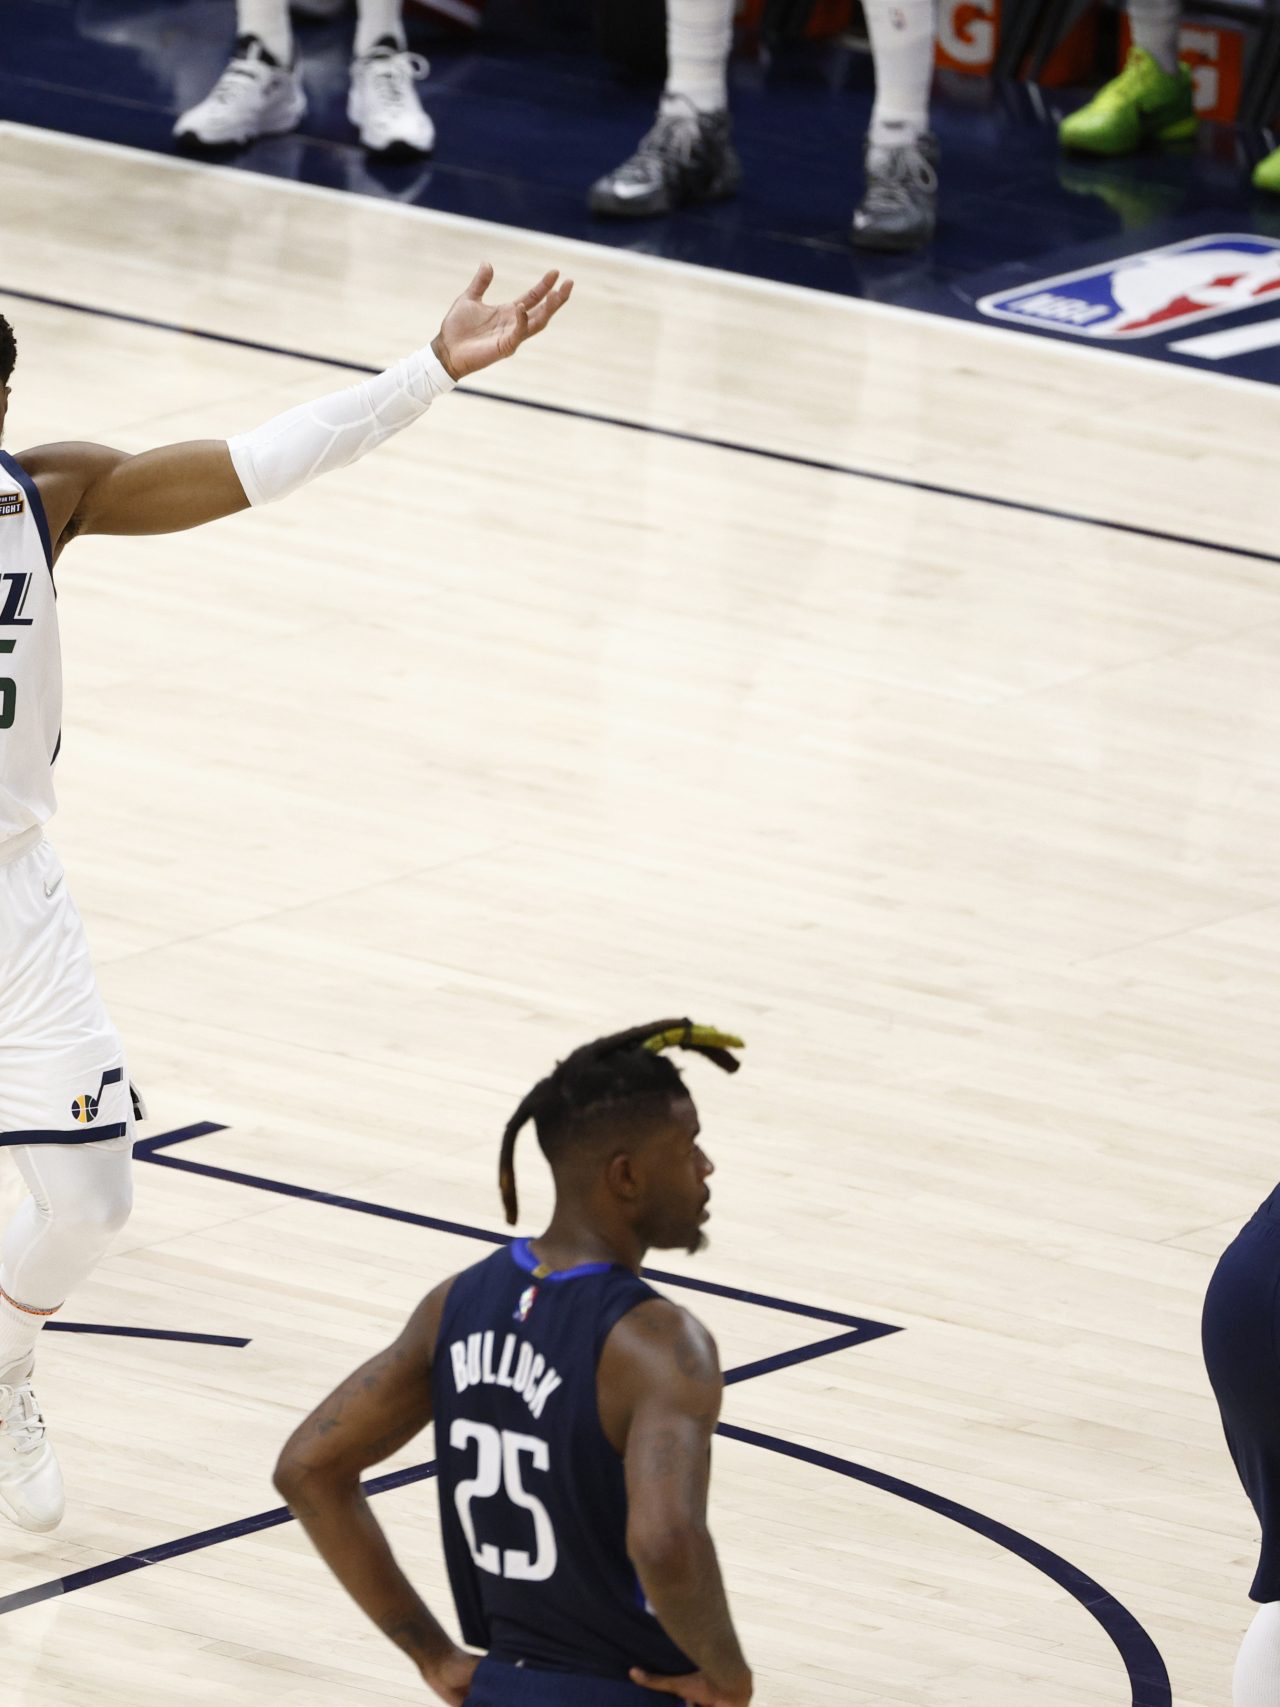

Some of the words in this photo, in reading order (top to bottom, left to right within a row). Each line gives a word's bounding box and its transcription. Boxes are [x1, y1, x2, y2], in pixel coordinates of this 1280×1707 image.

[1006, 293, 1111, 323] NBA
[450, 1330, 562, 1419] BULLOCK
[449, 1418, 558, 1582] 25
